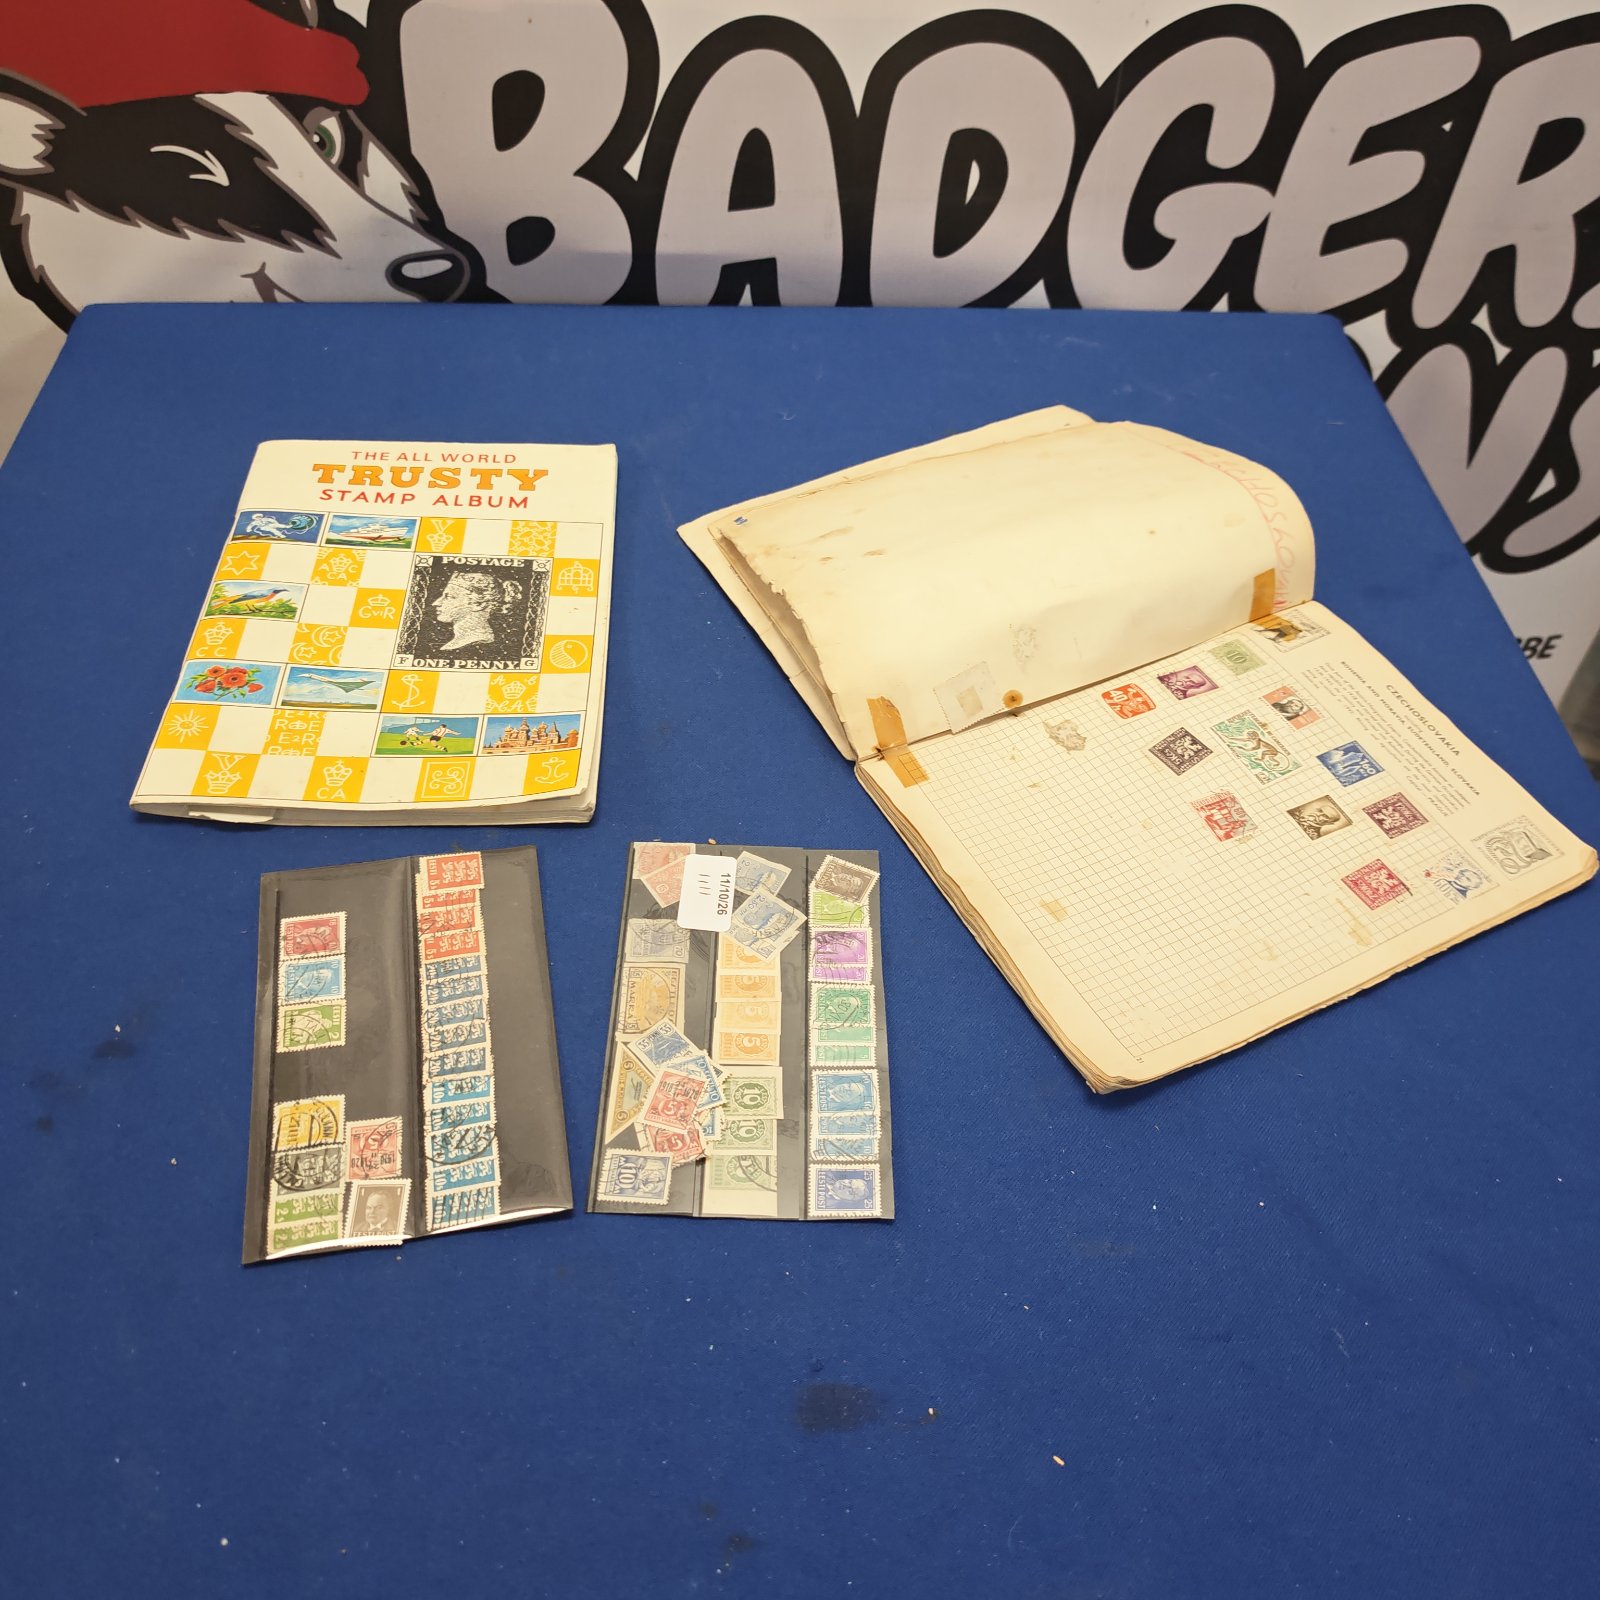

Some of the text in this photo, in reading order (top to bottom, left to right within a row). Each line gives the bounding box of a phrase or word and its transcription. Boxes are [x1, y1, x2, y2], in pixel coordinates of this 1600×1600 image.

[397, 0, 1600, 329] BADGER
[352, 451, 516, 464] THE ALL WORLD
[311, 463, 549, 491] TRUSTY
[319, 488, 529, 509] STAMP ALBUM
[441, 555, 525, 567] POSTAGE
[1517, 633, 1563, 659] BE
[397, 656, 407, 666] F
[411, 658, 451, 669] ONE
[523, 659, 536, 667] G
[1109, 690, 1129, 703] 40
[1385, 684, 1461, 757] CZECHOSLOVAKIA
[1367, 685, 1380, 698] AND
[1450, 768, 1480, 796] SLOVAKIA
[316, 787, 346, 800] CA
[716, 872, 731, 916] 11/10/26
[817, 1171, 826, 1209] EESTI POST
[864, 1198, 873, 1209] 25
